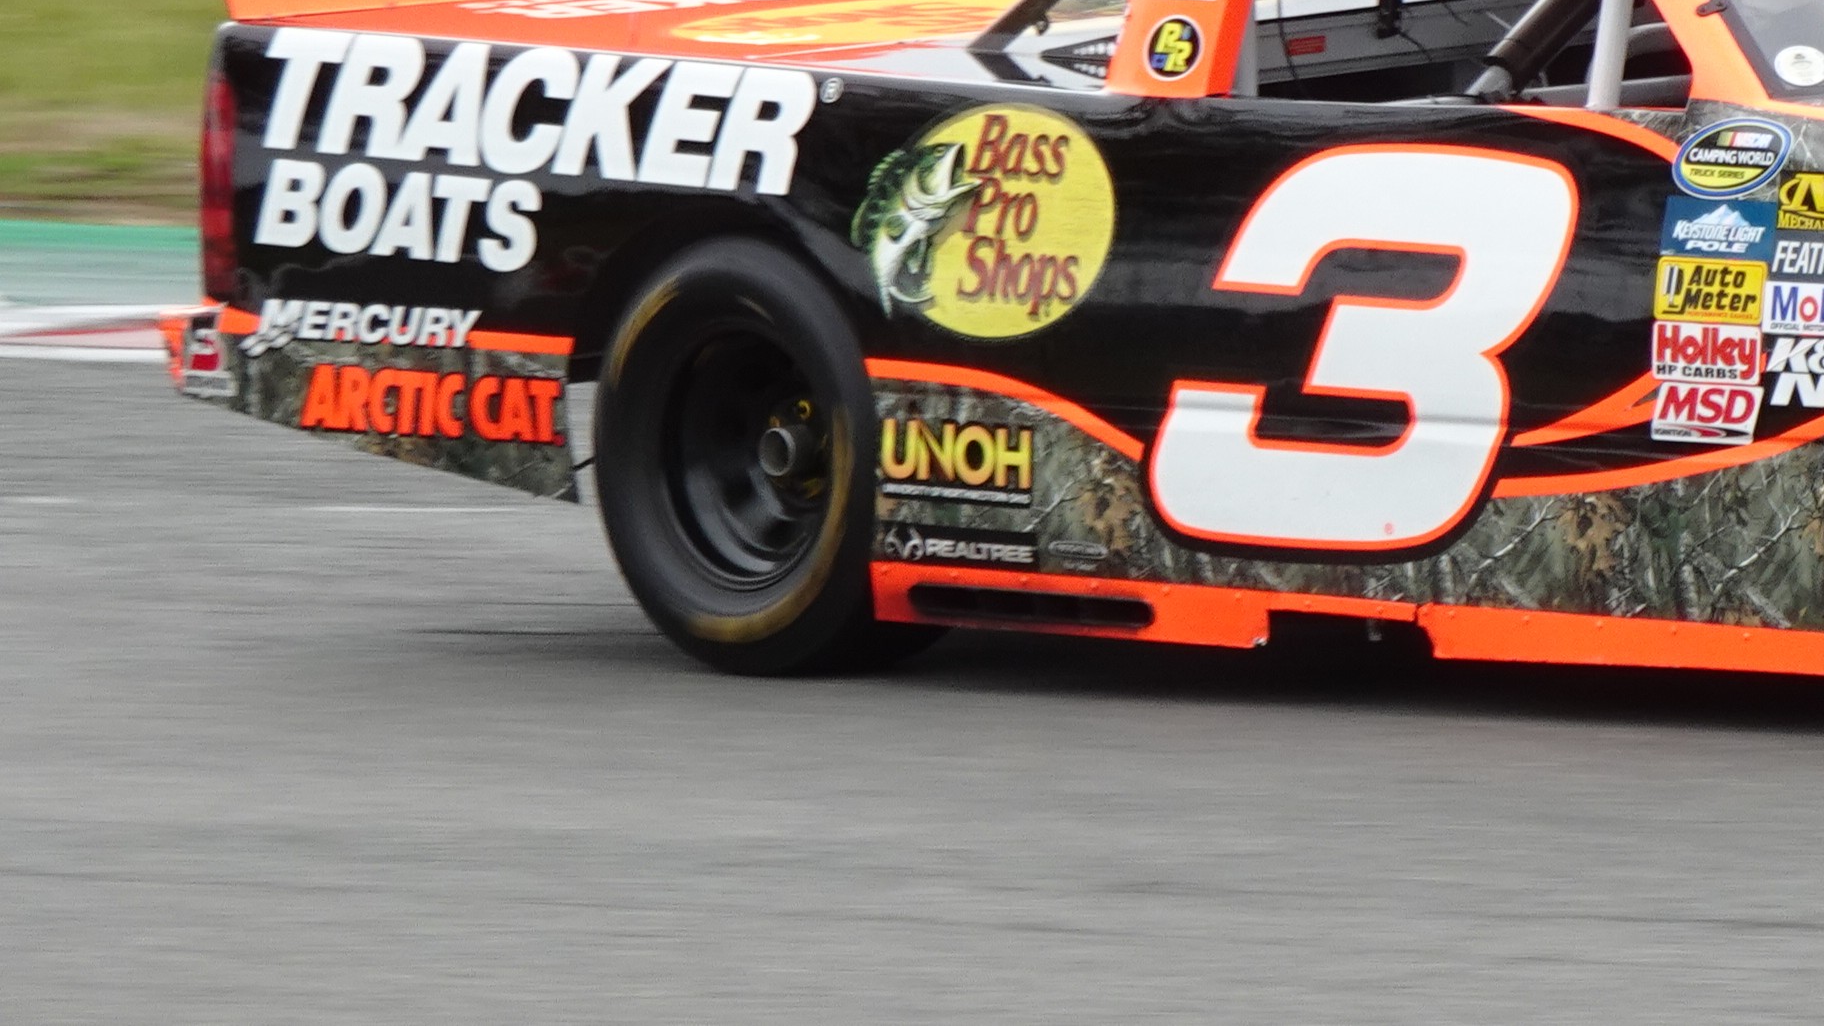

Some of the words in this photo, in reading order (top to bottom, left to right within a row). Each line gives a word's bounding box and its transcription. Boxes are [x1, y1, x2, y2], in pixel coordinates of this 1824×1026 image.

[263, 27, 816, 195] TRACKER
[966, 114, 1069, 177] Bass
[1688, 148, 1736, 165] CAMPING
[1737, 150, 1775, 166] WORLD
[1689, 167, 1716, 177] TRUCK
[254, 159, 542, 272] BOATS
[962, 176, 1038, 238] Pro
[1672, 219, 1731, 242] KEYSTONE
[1729, 224, 1766, 243] LIGHT
[1685, 240, 1749, 253] POLE
[957, 236, 1079, 316] Shops
[1688, 265, 1746, 288] Auto
[1683, 287, 1757, 312] Meter
[240, 299, 482, 357] MERCURY
[1149, 143, 1580, 551] 3
[1770, 322, 1799, 331] OFFICIAL
[1656, 324, 1757, 378] Holley
[1657, 364, 1680, 375] HP
[1682, 365, 1738, 379] CARBS
[301, 363, 465, 439] ARCTIC
[1658, 385, 1755, 424] MSD
[880, 418, 1032, 490] UNOH
[925, 537, 1034, 563] REALTREE
